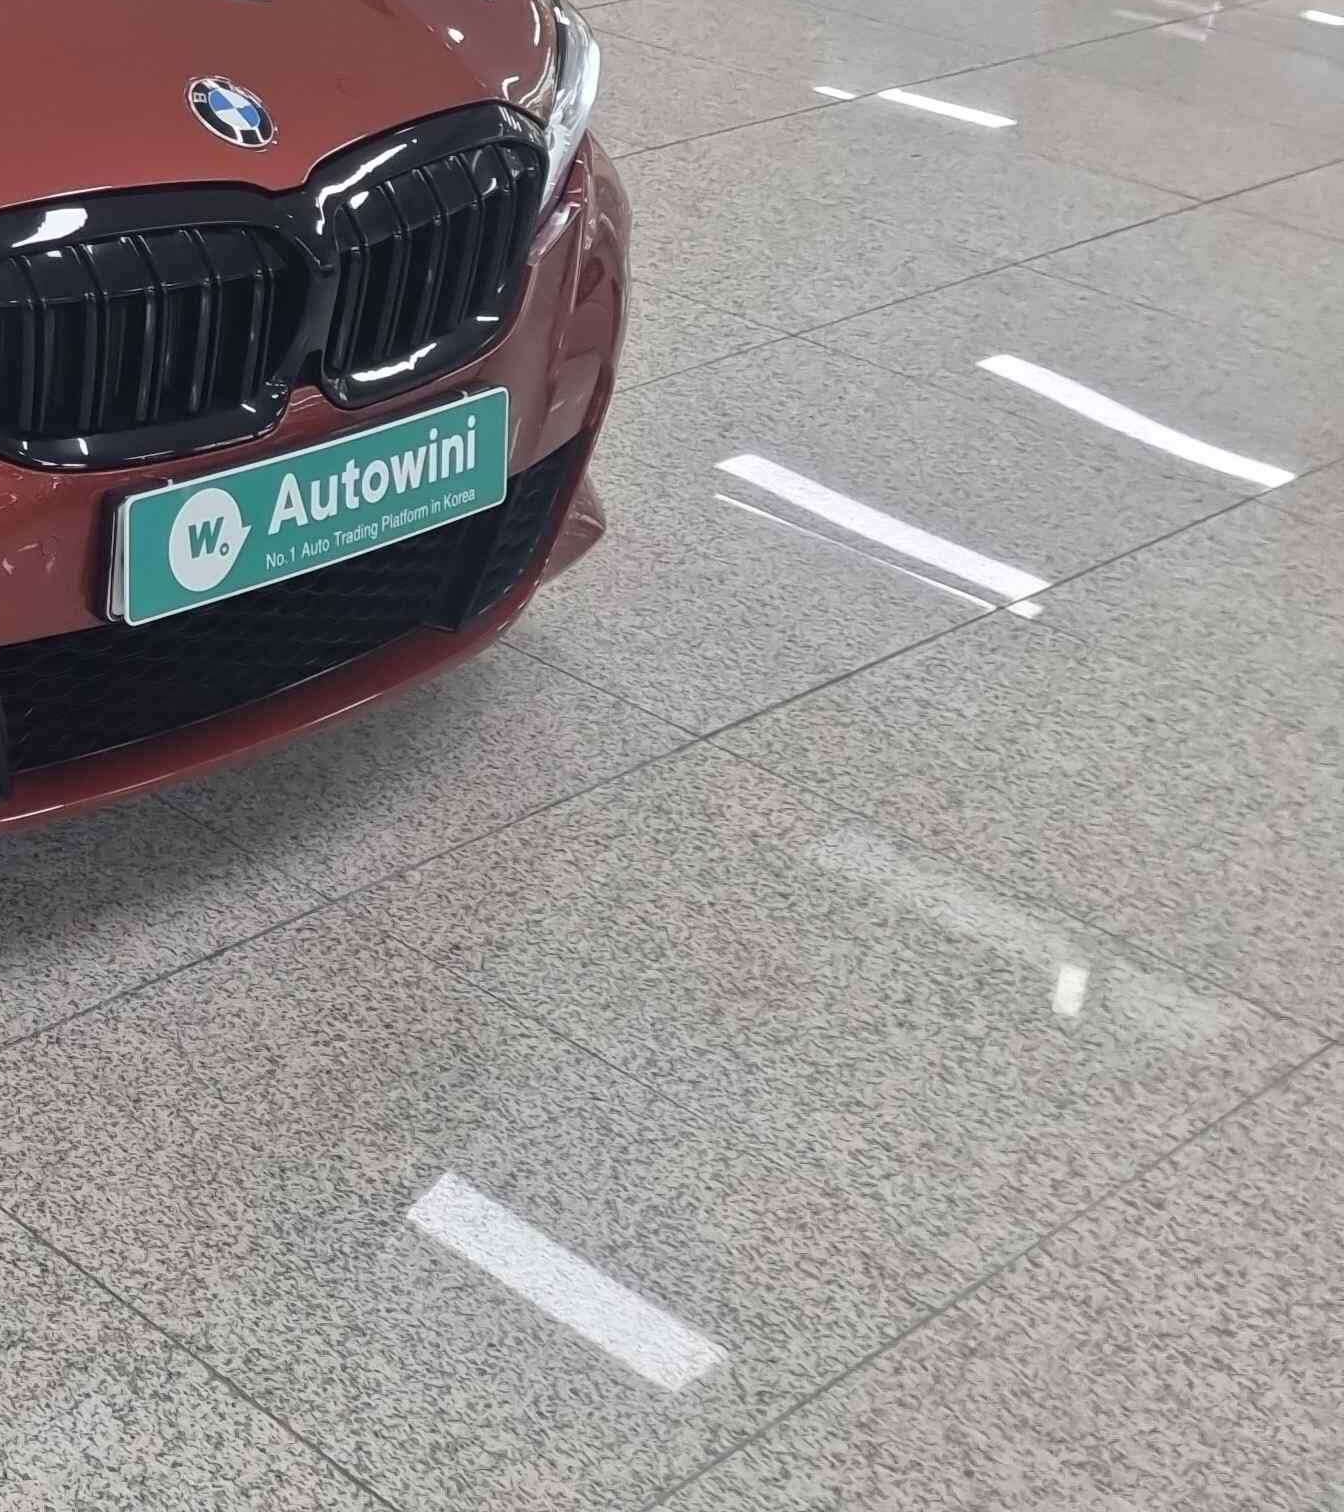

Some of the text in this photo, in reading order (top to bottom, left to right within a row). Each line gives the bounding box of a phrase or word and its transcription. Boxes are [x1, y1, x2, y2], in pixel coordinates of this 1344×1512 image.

[267, 414, 477, 536] Autowini
[301, 538, 330, 559] Auto
[334, 520, 378, 547] Trading
[381, 506, 430, 532] Platform
[431, 499, 441, 515] in
[443, 487, 476, 513] Korea
